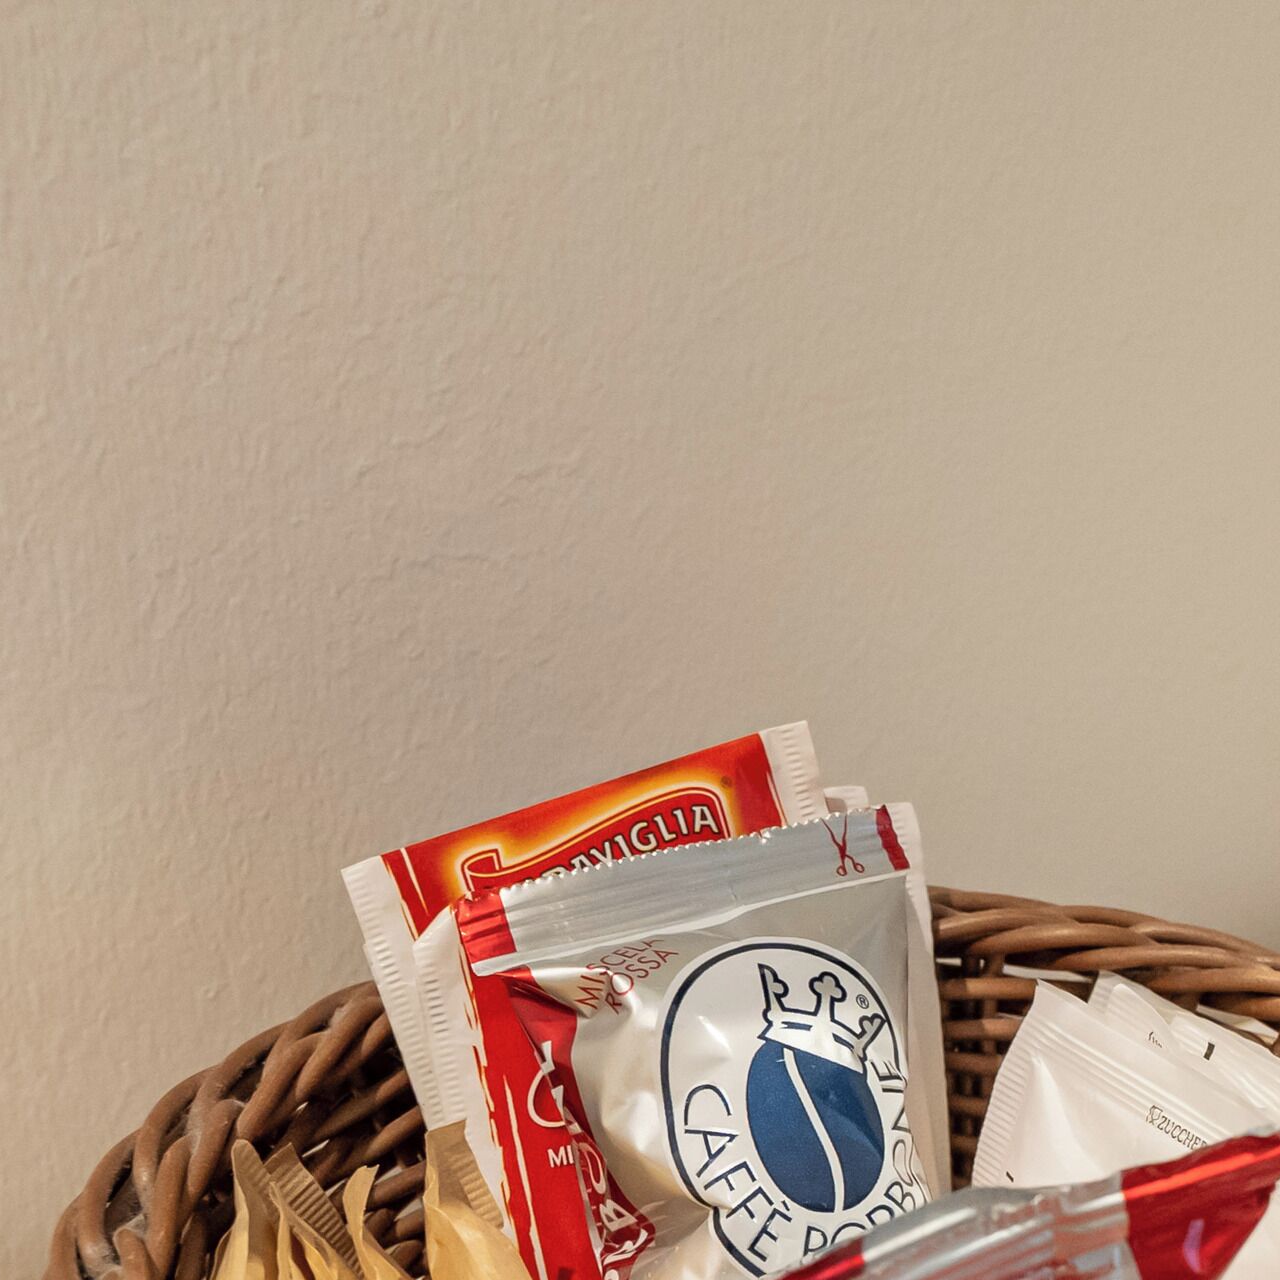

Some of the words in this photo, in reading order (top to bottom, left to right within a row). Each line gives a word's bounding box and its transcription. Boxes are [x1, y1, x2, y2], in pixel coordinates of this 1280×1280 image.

[522, 804, 719, 884] AVIGLIA
[604, 949, 679, 1015] ROSSA
[684, 1084, 792, 1262] CAFFÈ
